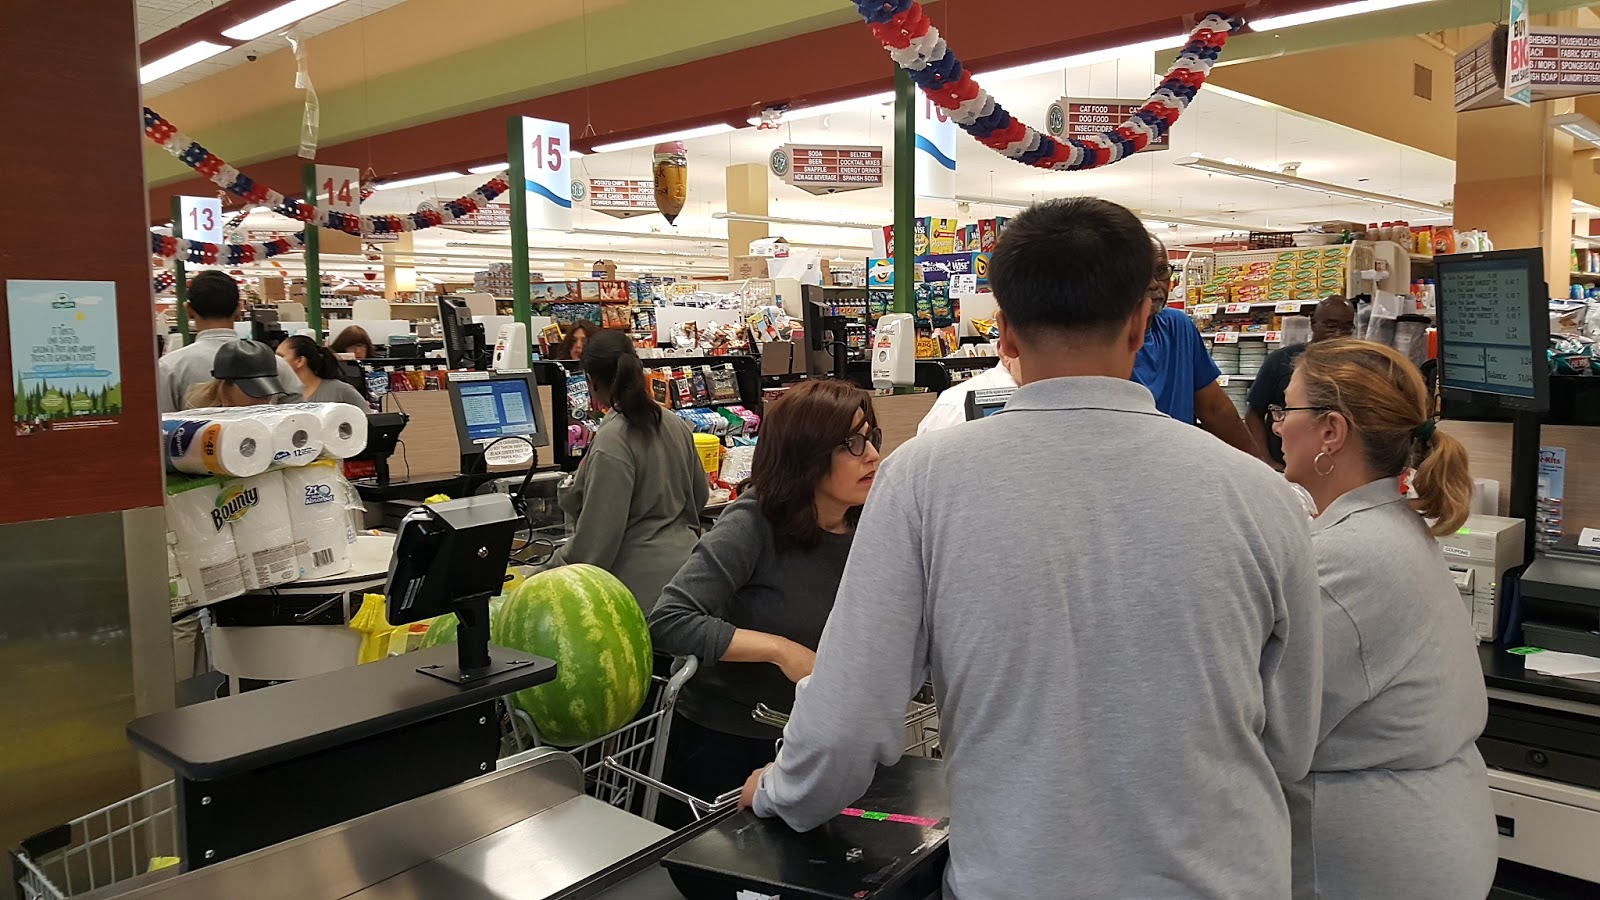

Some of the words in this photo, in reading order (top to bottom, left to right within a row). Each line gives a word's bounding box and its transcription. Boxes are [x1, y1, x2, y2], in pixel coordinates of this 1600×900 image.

[1514, 20, 1526, 38] BUY
[1561, 38, 1587, 46] HOUSEHOLD
[1561, 50, 1580, 58] FABRIC
[1538, 61, 1556, 69] MOPS
[1541, 73, 1558, 81] SOAP
[1561, 74, 1582, 82] LAUNDRY
[1051, 112, 1062, 128] 18
[532, 135, 562, 172] 15
[774, 155, 786, 170] 17
[323, 178, 352, 207] 14
[190, 207, 214, 231] 13
[952, 261, 969, 270] WISE
[567, 381, 588, 393] Welch's
[211, 487, 259, 533] Bounty
[1445, 547, 1469, 556] COUPONS
